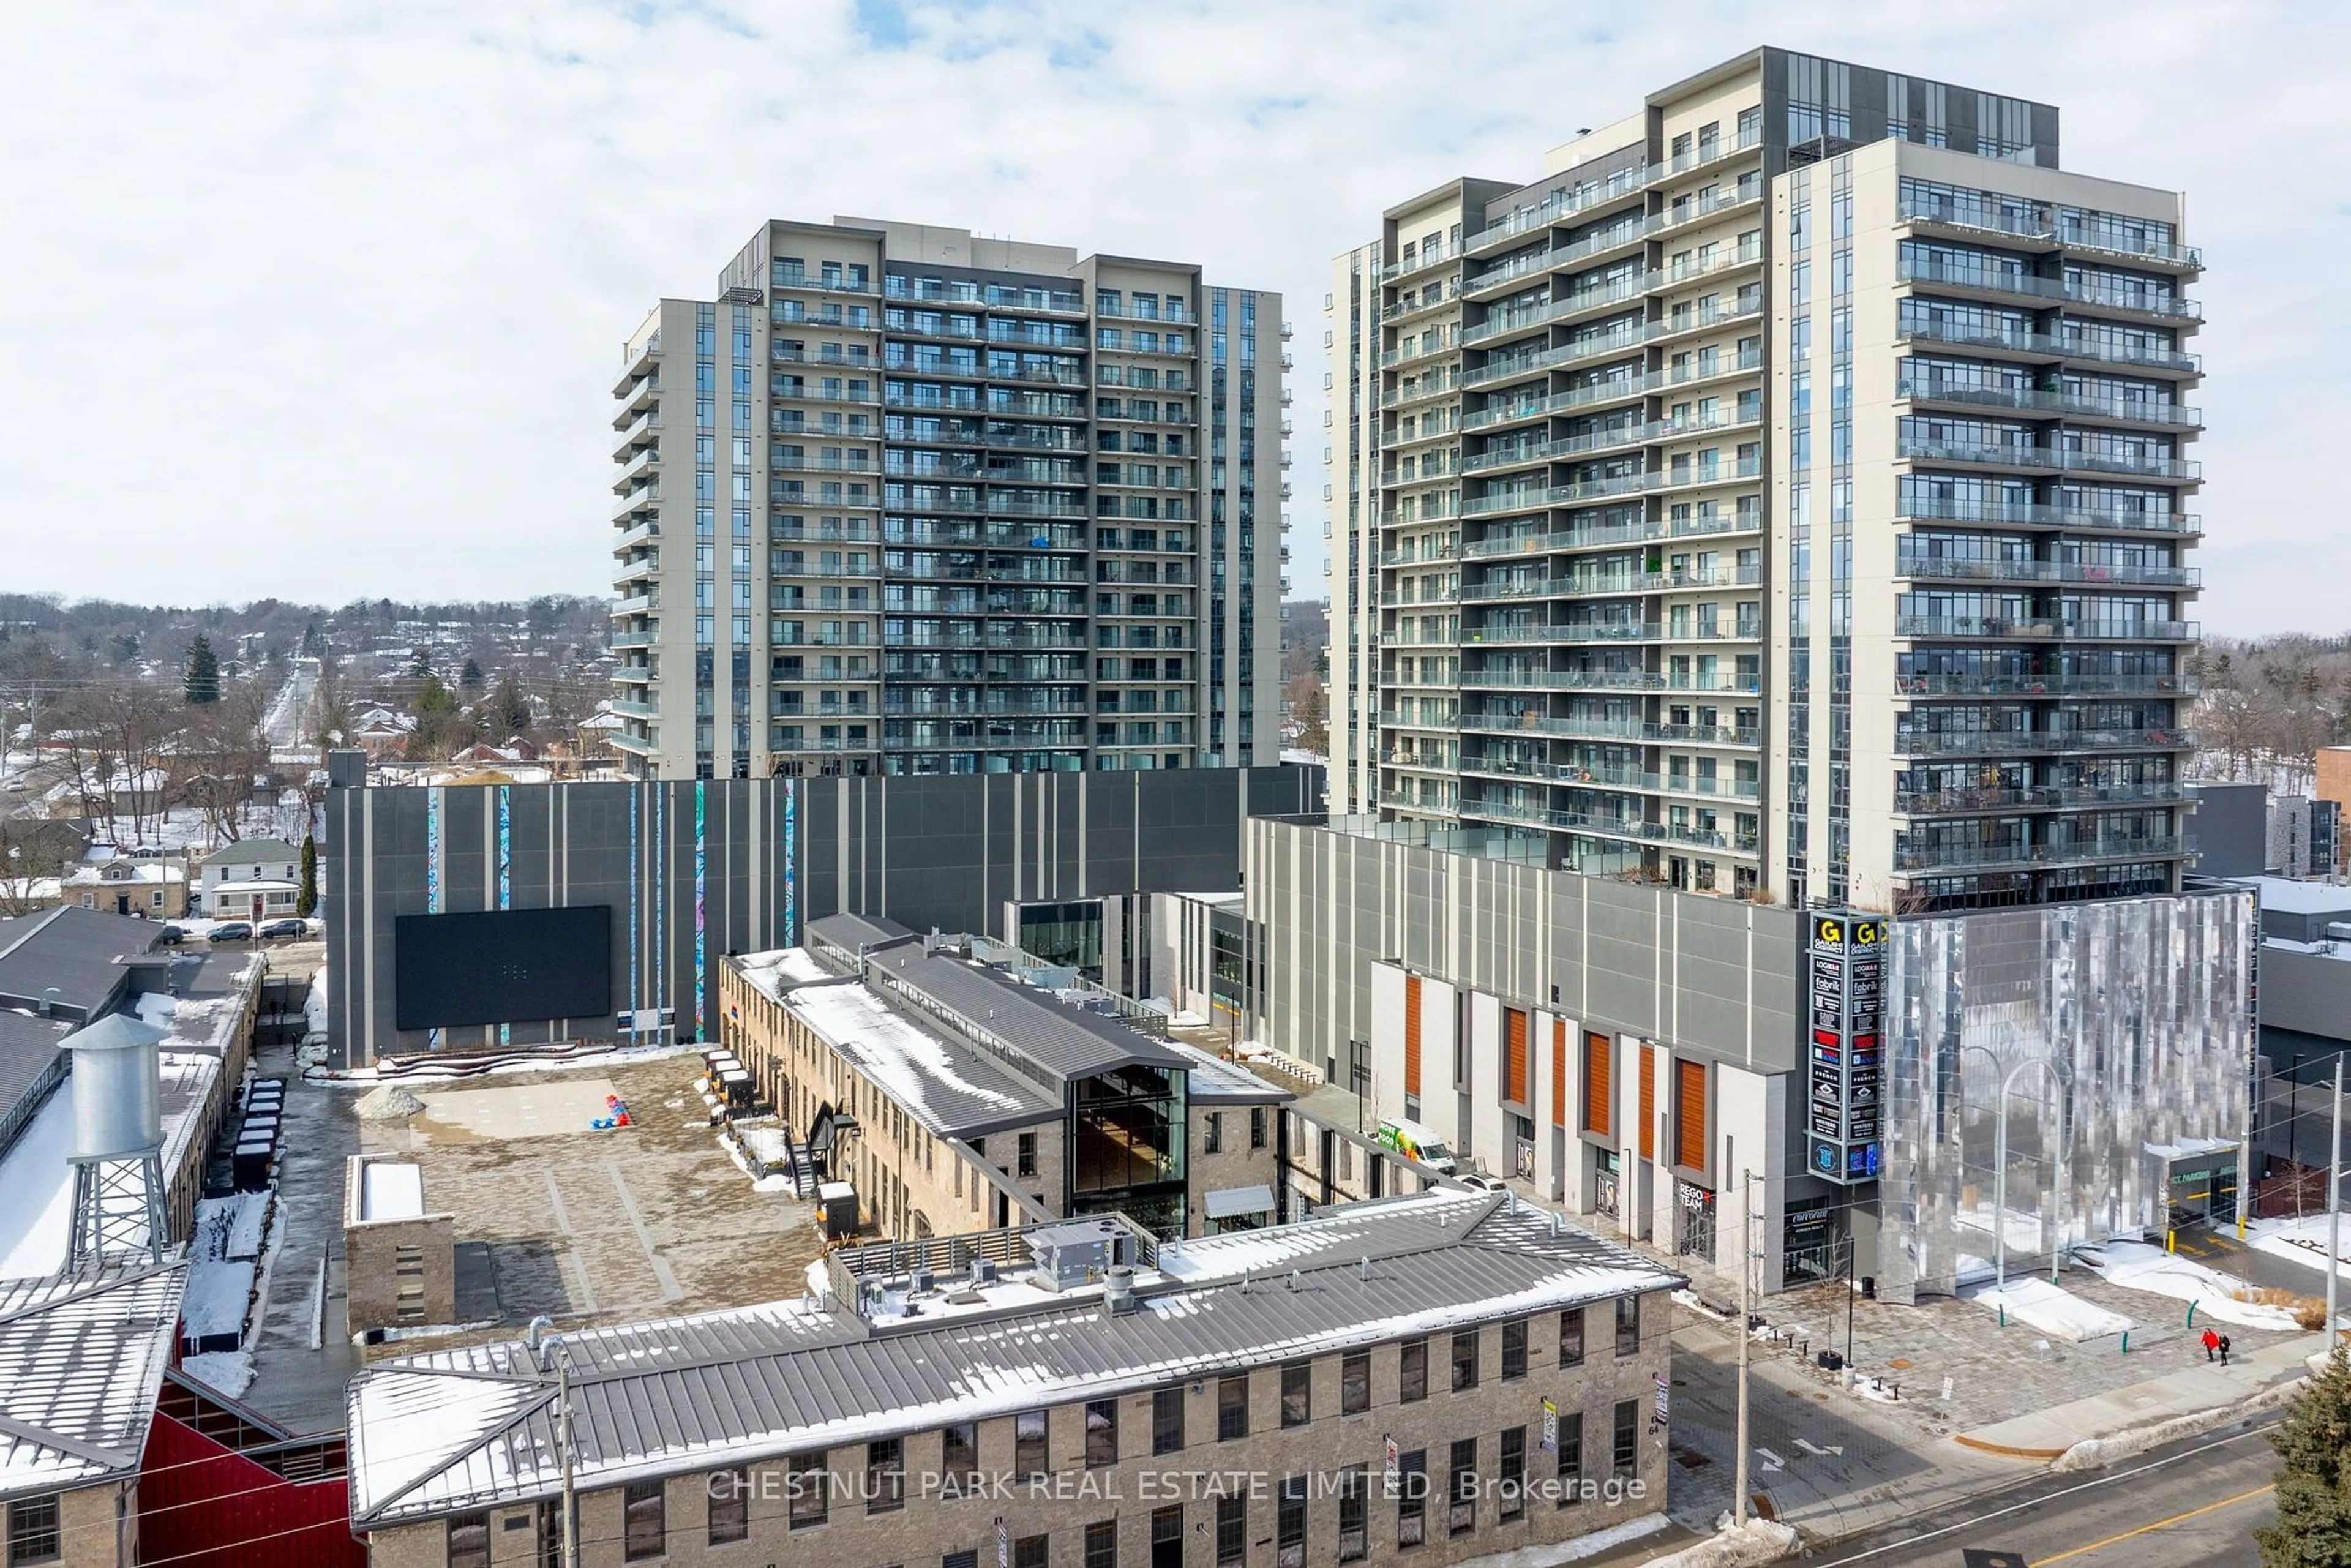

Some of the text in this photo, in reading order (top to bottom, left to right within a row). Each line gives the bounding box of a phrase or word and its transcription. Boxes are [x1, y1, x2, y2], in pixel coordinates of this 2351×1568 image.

[1816, 978, 1839, 991] fabrik
[1854, 981, 1877, 992] fabrik
[1681, 1184, 1703, 1200] REGO
[1681, 1194, 1702, 1212] TEAM
[1649, 1426, 1659, 1435] 64
